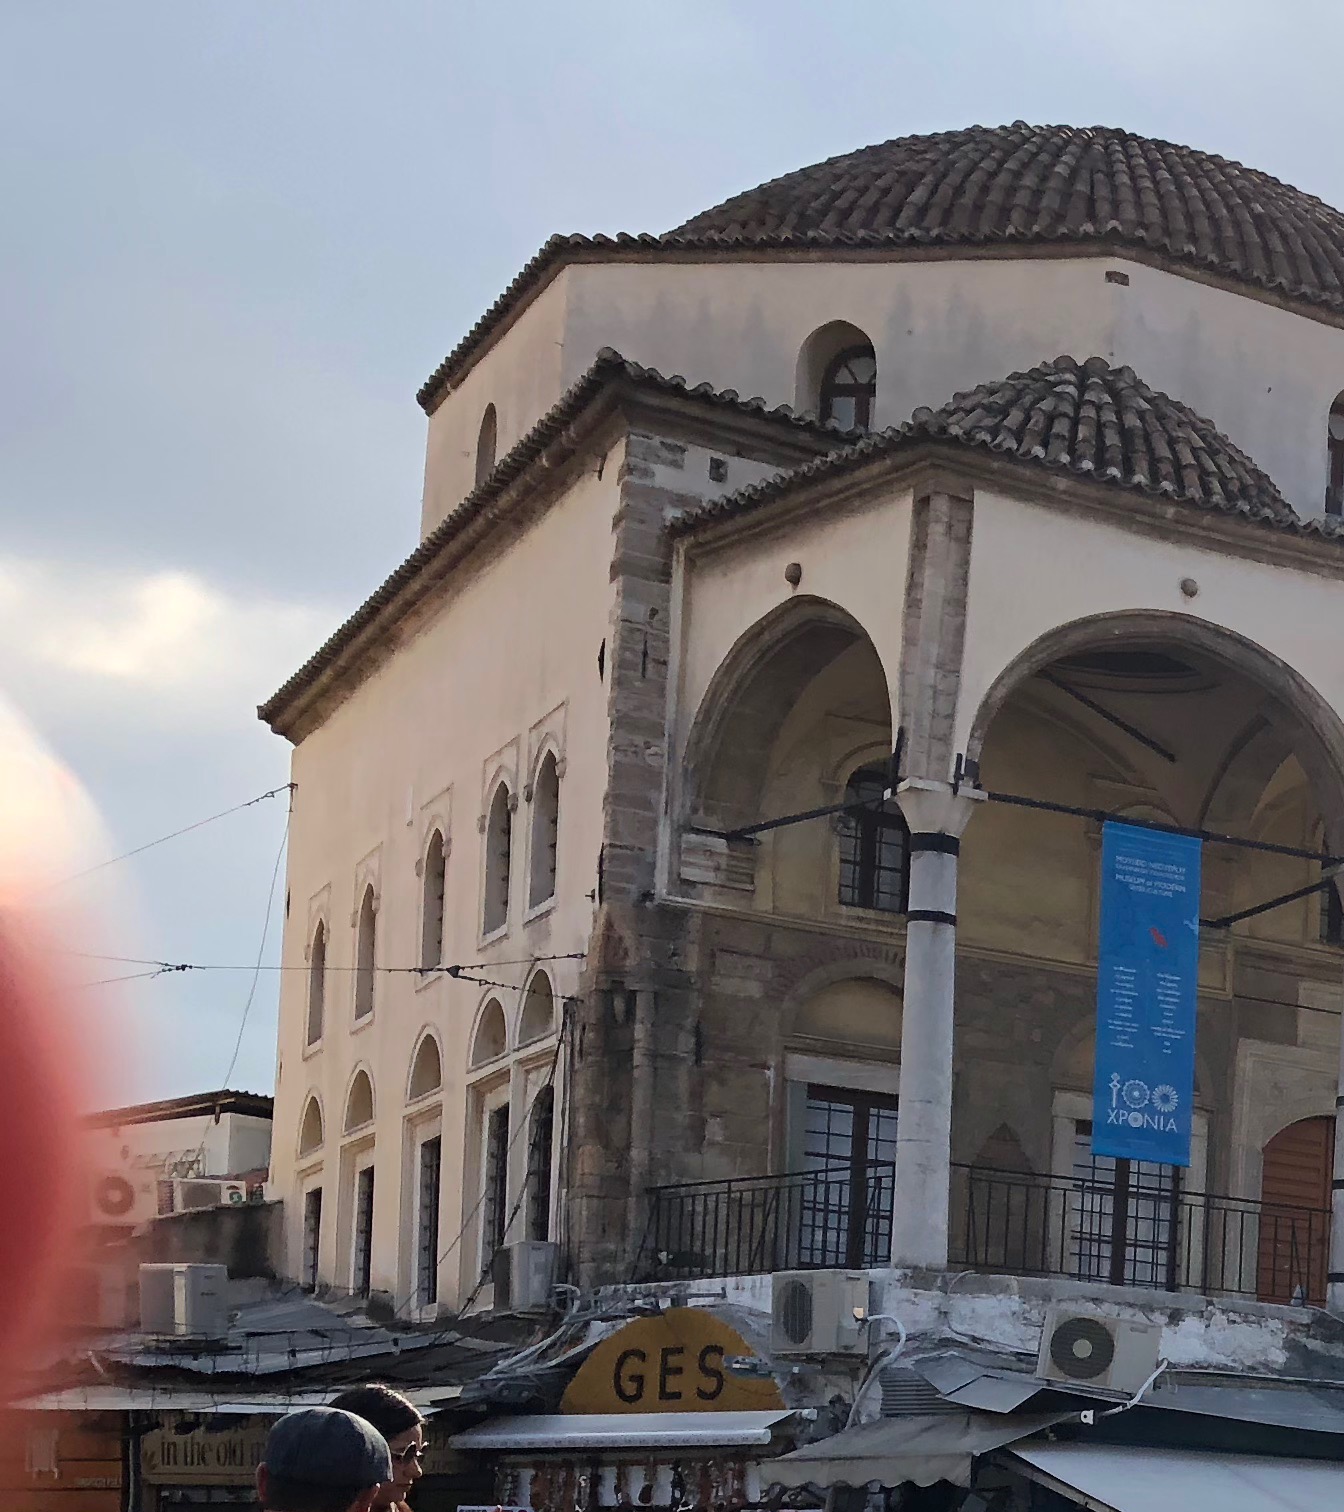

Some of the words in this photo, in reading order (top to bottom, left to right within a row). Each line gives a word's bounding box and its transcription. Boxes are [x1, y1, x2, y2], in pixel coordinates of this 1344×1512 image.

[613, 1344, 725, 1404] GES
[161, 1438, 178, 1466] in
[184, 1438, 211, 1466] the
[216, 1438, 244, 1467] old
